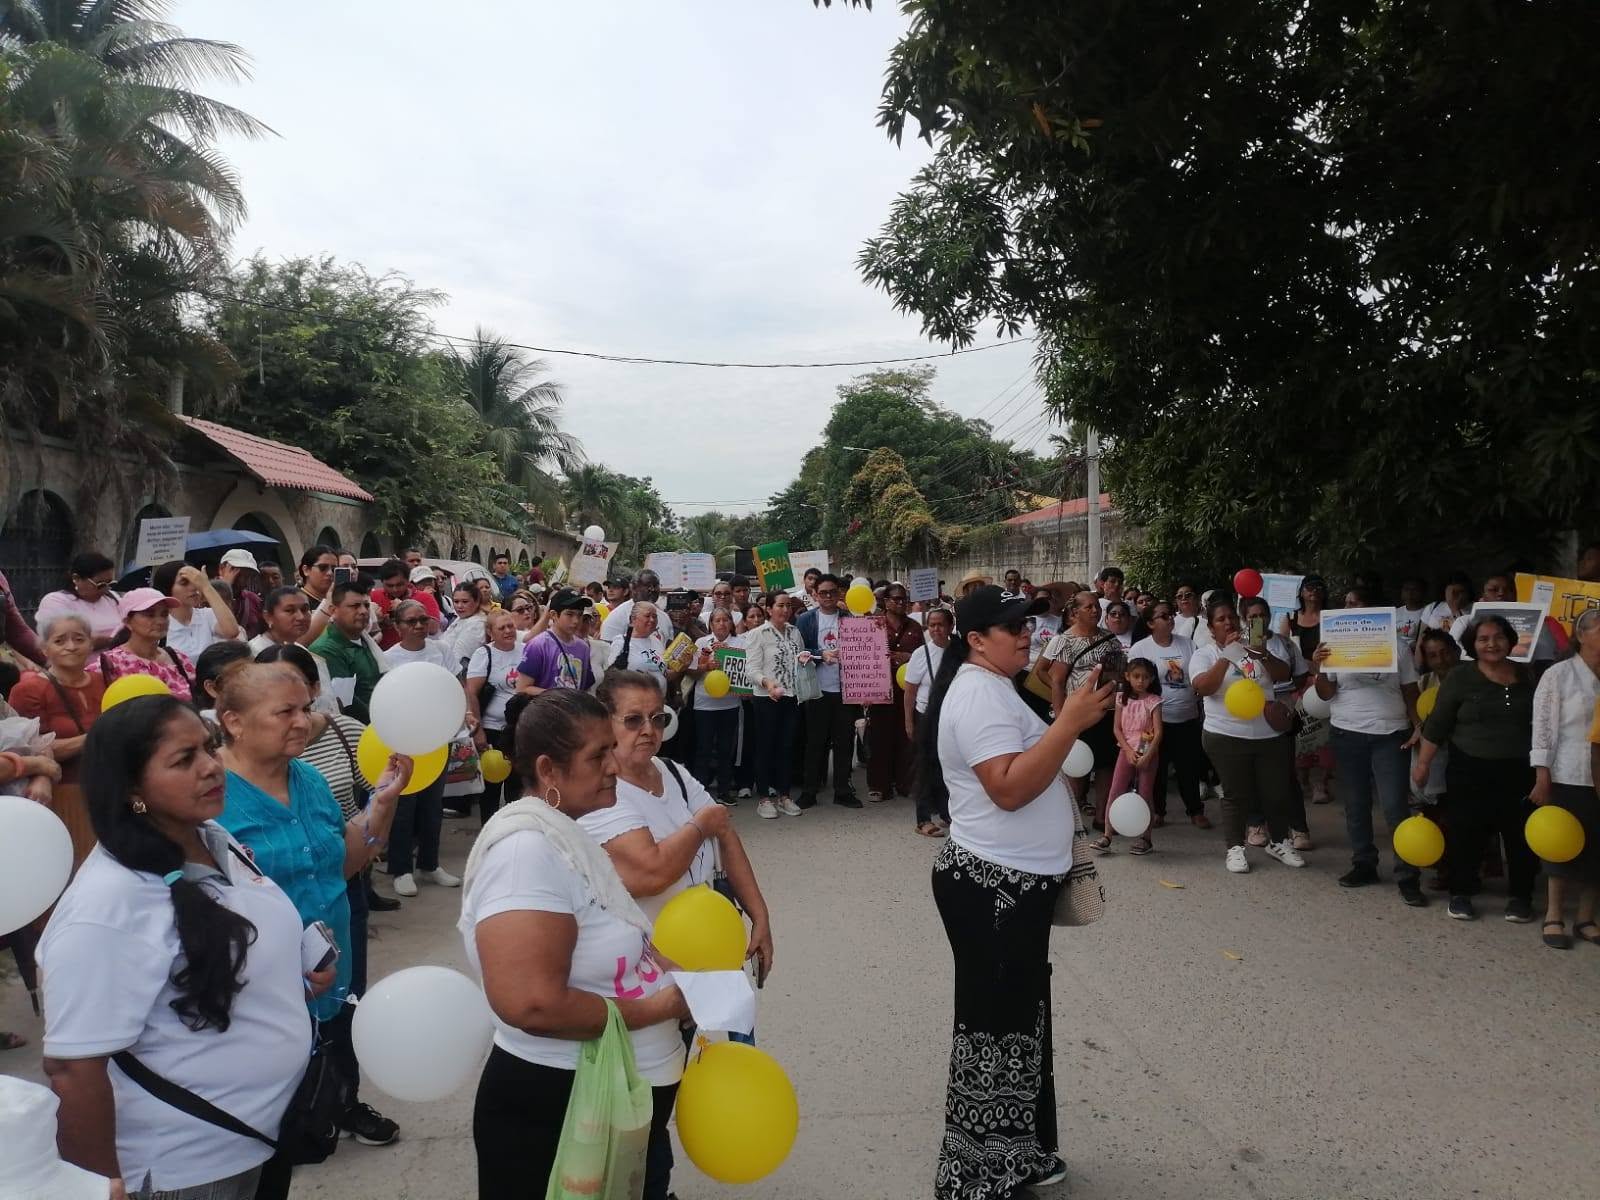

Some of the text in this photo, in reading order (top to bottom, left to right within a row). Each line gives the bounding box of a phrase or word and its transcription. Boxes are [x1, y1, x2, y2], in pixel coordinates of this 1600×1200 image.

[874, 642, 881, 651] la
[843, 663, 870, 673] palabra
[845, 690, 862, 699] para
